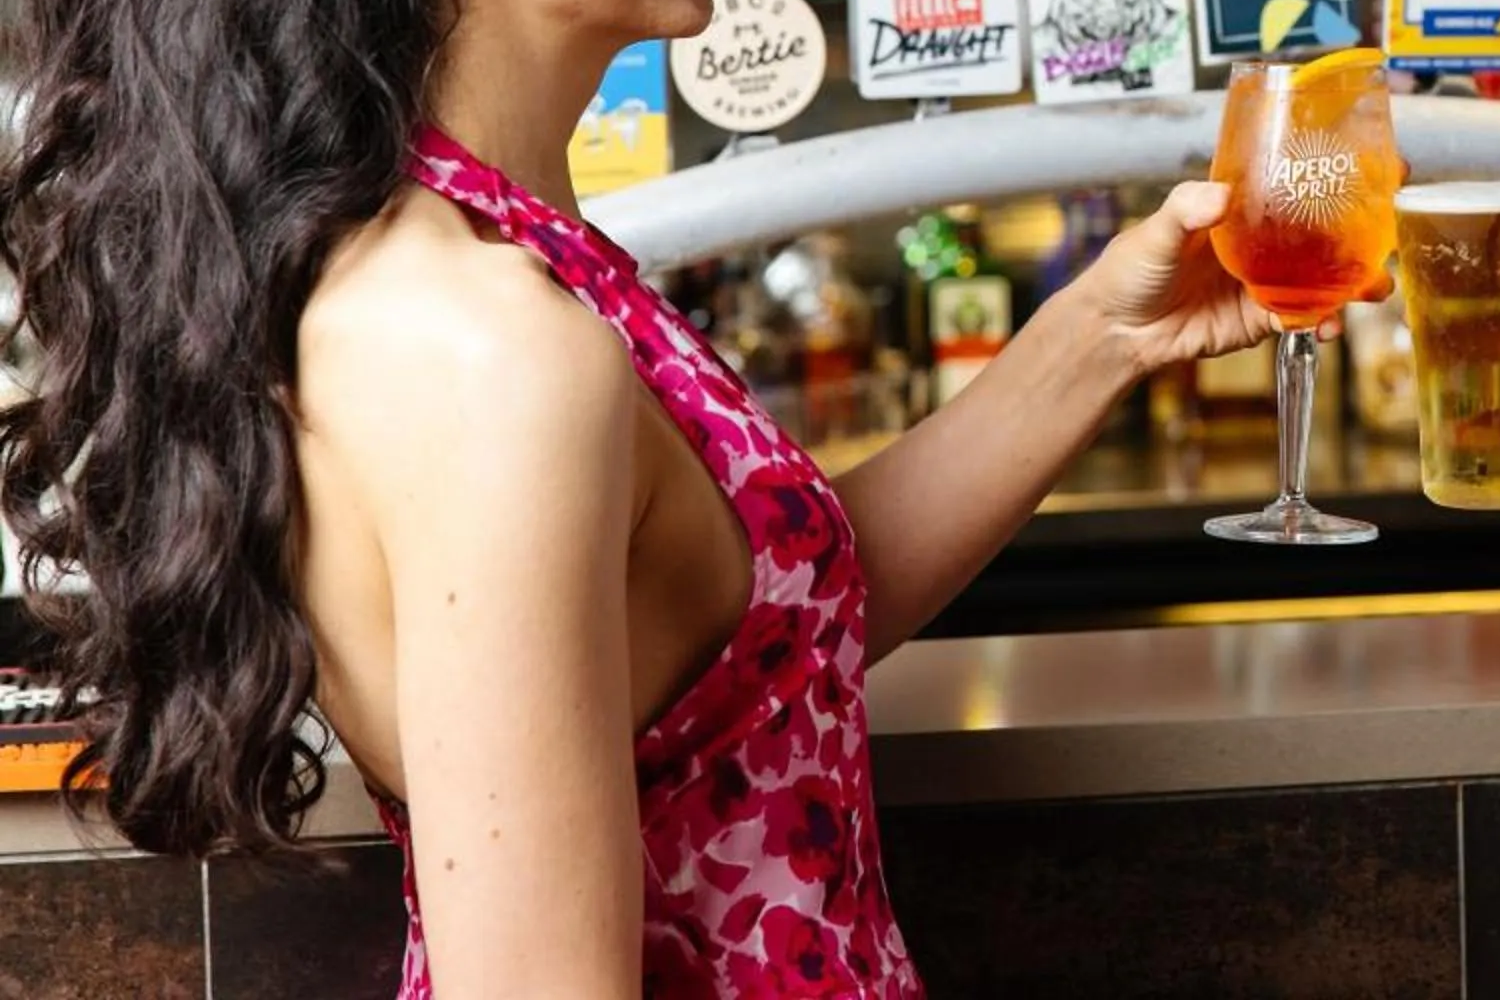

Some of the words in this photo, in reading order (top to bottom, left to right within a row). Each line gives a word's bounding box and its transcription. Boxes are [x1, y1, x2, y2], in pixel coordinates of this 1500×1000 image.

[697, 31, 807, 81] Bertie
[869, 18, 1016, 67] DRAUGHT
[1270, 152, 1360, 189] APEROL
[1283, 174, 1348, 202] SPRITZ
